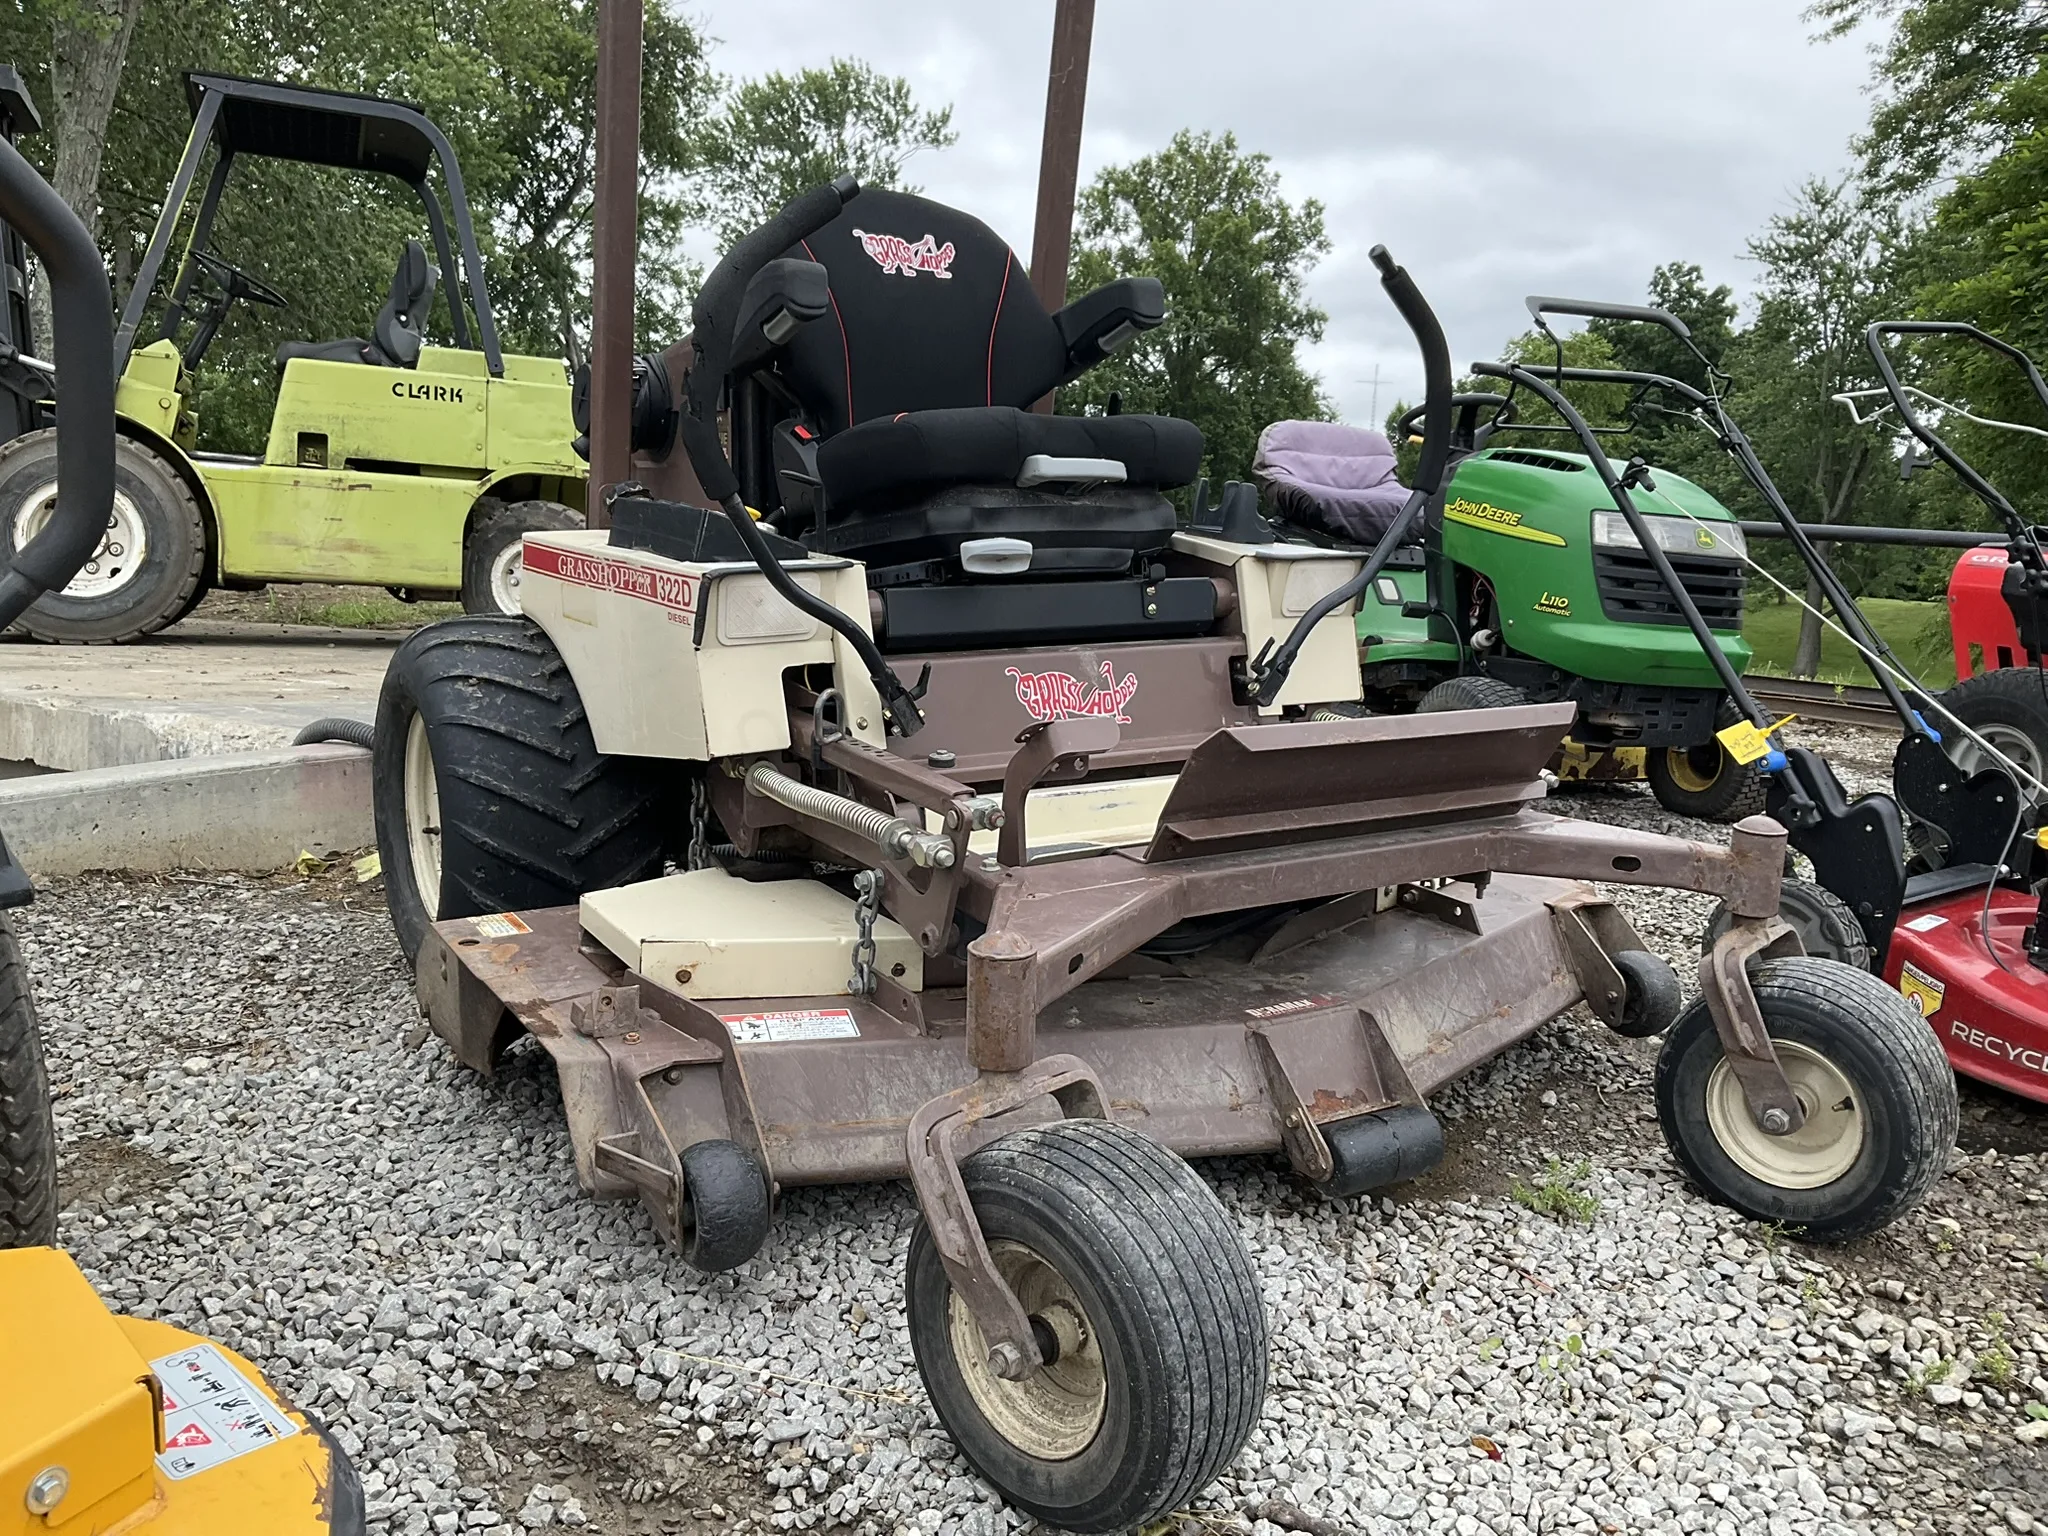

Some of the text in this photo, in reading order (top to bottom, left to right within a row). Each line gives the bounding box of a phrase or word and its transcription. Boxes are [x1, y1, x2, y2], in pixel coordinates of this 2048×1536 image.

[391, 382, 463, 403] CLARK
[1450, 496, 1522, 526] JOHN DEERE
[557, 555, 692, 607] GRASSHOPPER 322D
[1540, 591, 1569, 608] L110
[667, 612, 691, 626] DIESEL
[1533, 603, 1572, 618] Automatic
[763, 1011, 821, 1020] DANGER
